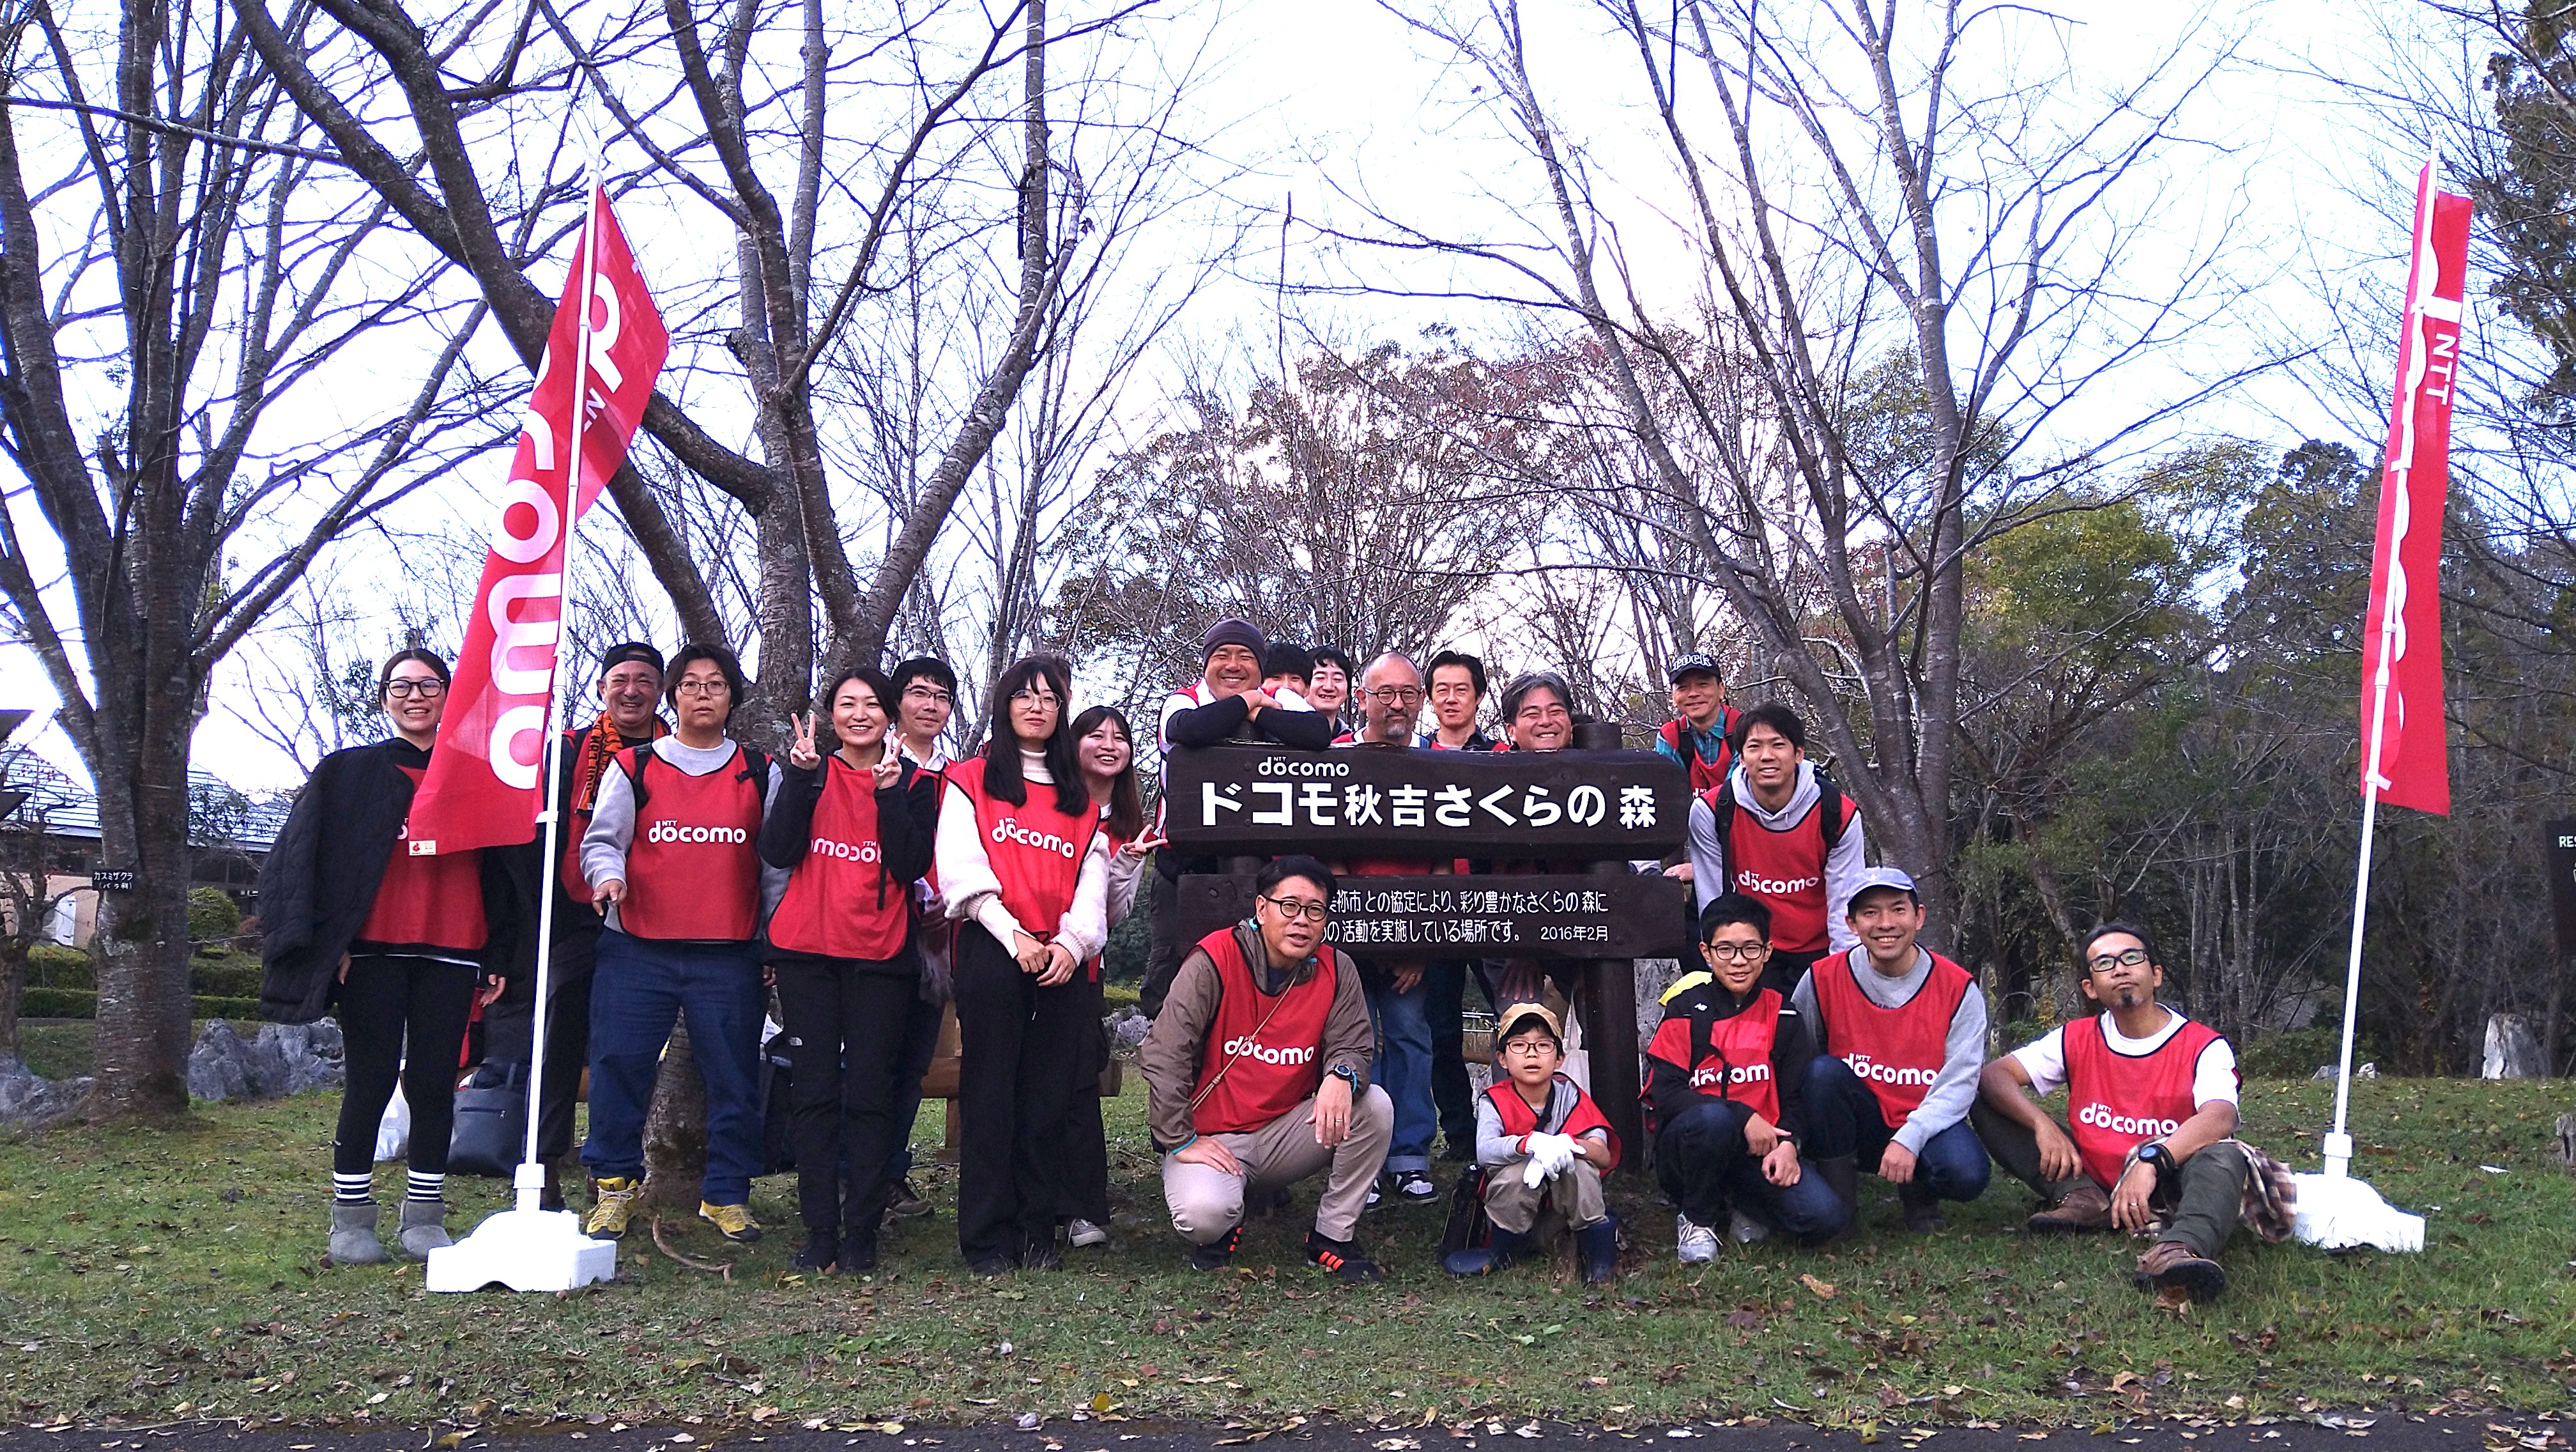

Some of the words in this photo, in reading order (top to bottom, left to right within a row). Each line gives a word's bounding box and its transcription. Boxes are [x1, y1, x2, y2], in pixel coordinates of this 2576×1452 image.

[2426, 332, 2457, 406] NTT
[1258, 756, 1349, 776] docomo
[1202, 782, 1657, 830] ドコモ秋吉さくらの森
[648, 821, 746, 844] docomo
[992, 818, 1075, 858] docomo
[1738, 870, 1819, 893] docomo
[1540, 925, 1608, 942] 2016年2月
[1224, 1035, 1314, 1065] docomo
[2080, 1102, 2179, 1135] docomo
